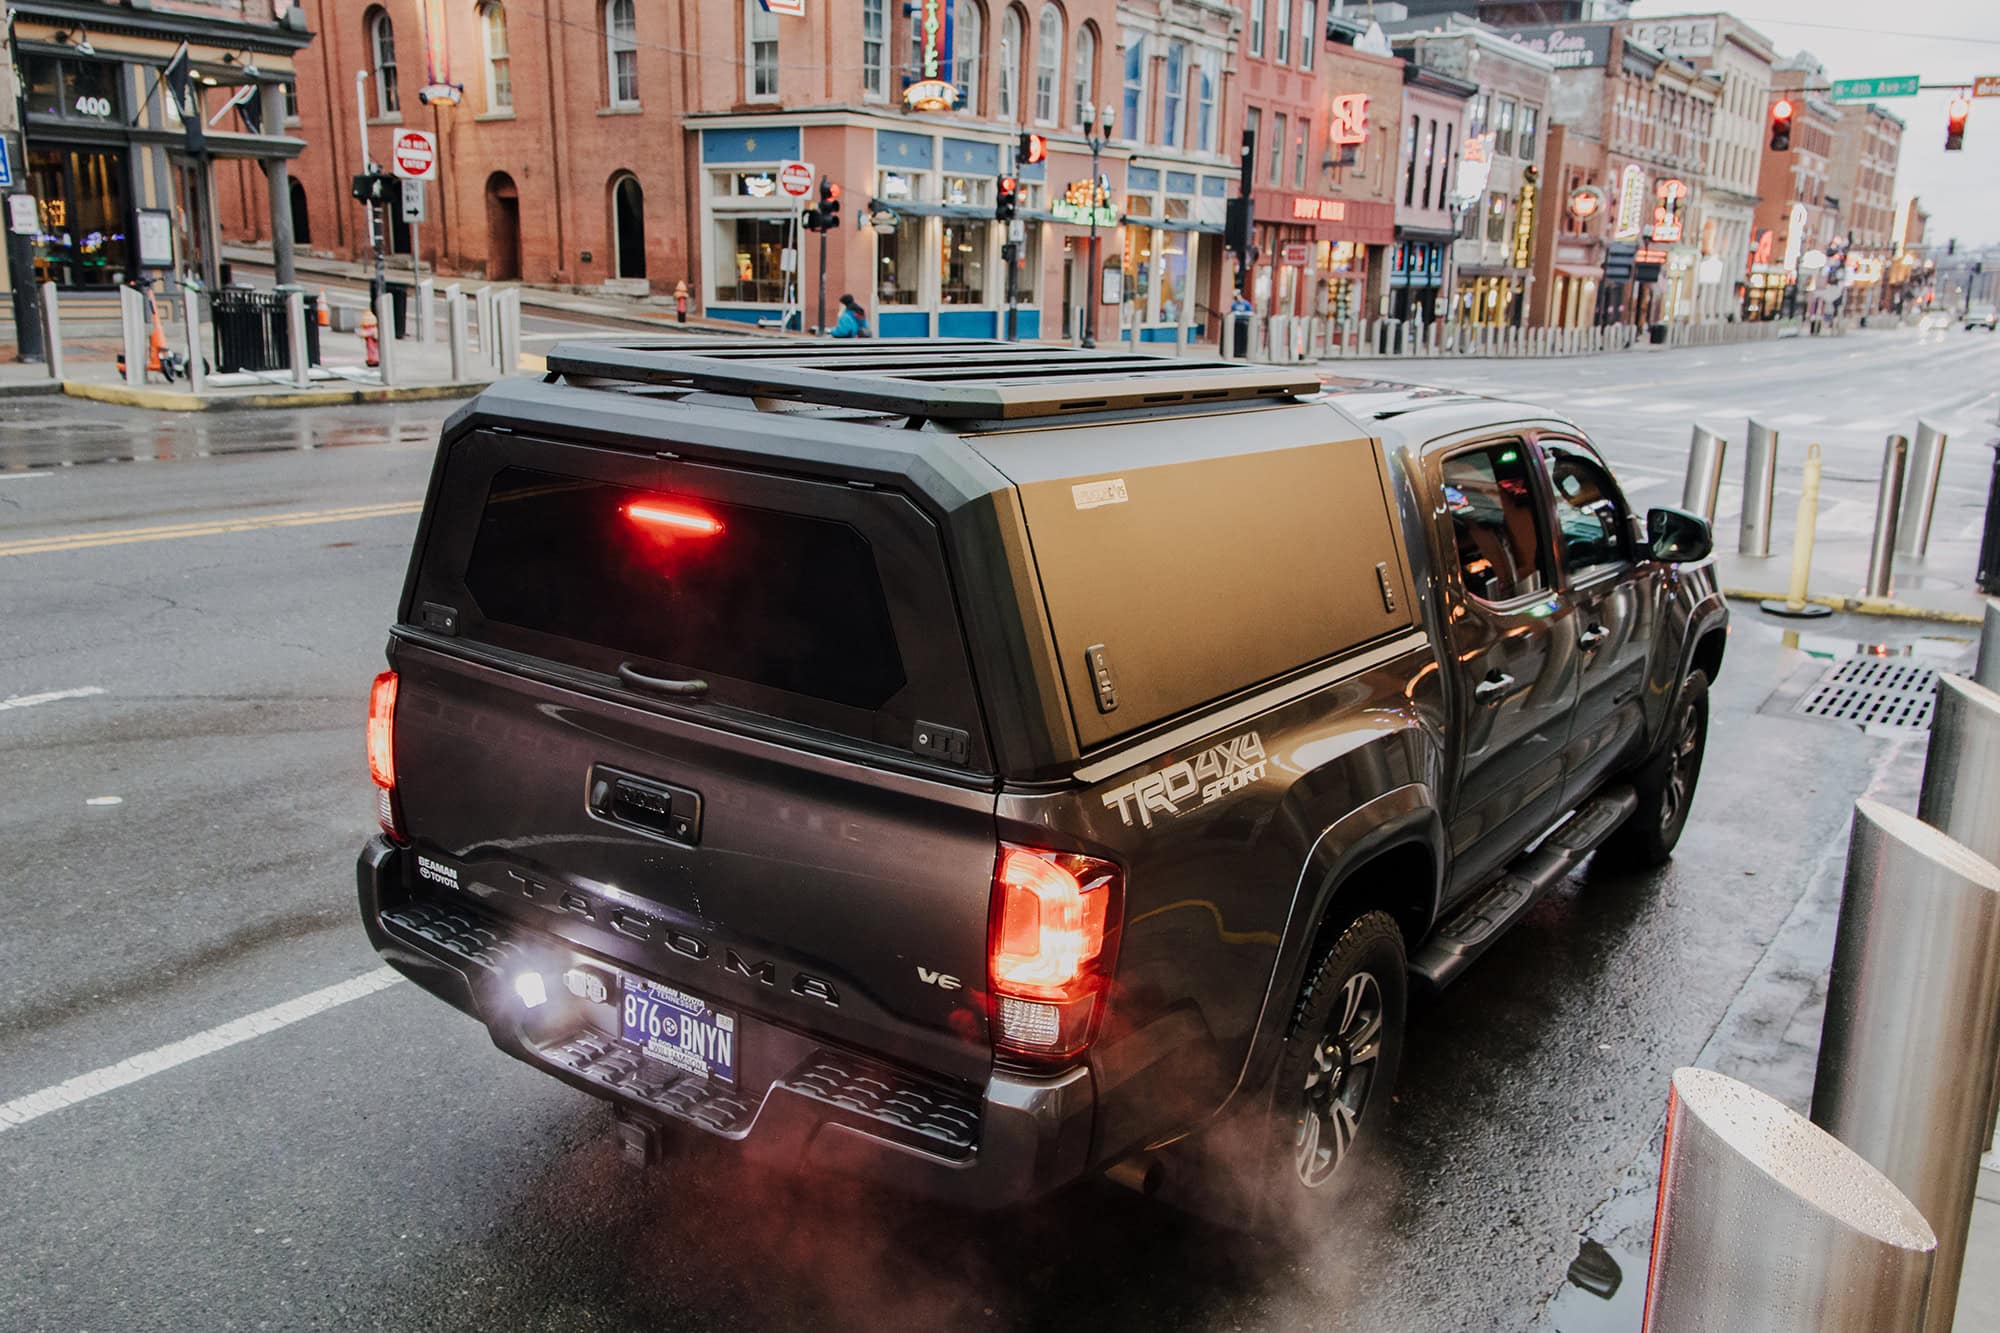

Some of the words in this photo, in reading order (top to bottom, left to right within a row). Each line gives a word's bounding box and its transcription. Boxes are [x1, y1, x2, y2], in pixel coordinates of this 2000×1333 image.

[75, 96, 111, 117] 400
[400, 139, 412, 149] DO
[413, 141, 429, 151] NOT
[403, 159, 426, 170] ENTER
[1101, 761, 1199, 829] TRD
[1195, 730, 1268, 781] 4X4
[1202, 758, 1268, 804] SPORT
[418, 856, 457, 880] BEAMAN
[430, 871, 460, 890] TOYOTA
[508, 869, 840, 1008] TACOMA
[916, 966, 962, 990] V6
[648, 980, 679, 998] BEAMAN
[679, 991, 705, 1007] TOYOTA
[656, 990, 700, 1013] TENNESSEE
[624, 993, 661, 1038] 876
[679, 1014, 732, 1068] BNYN
